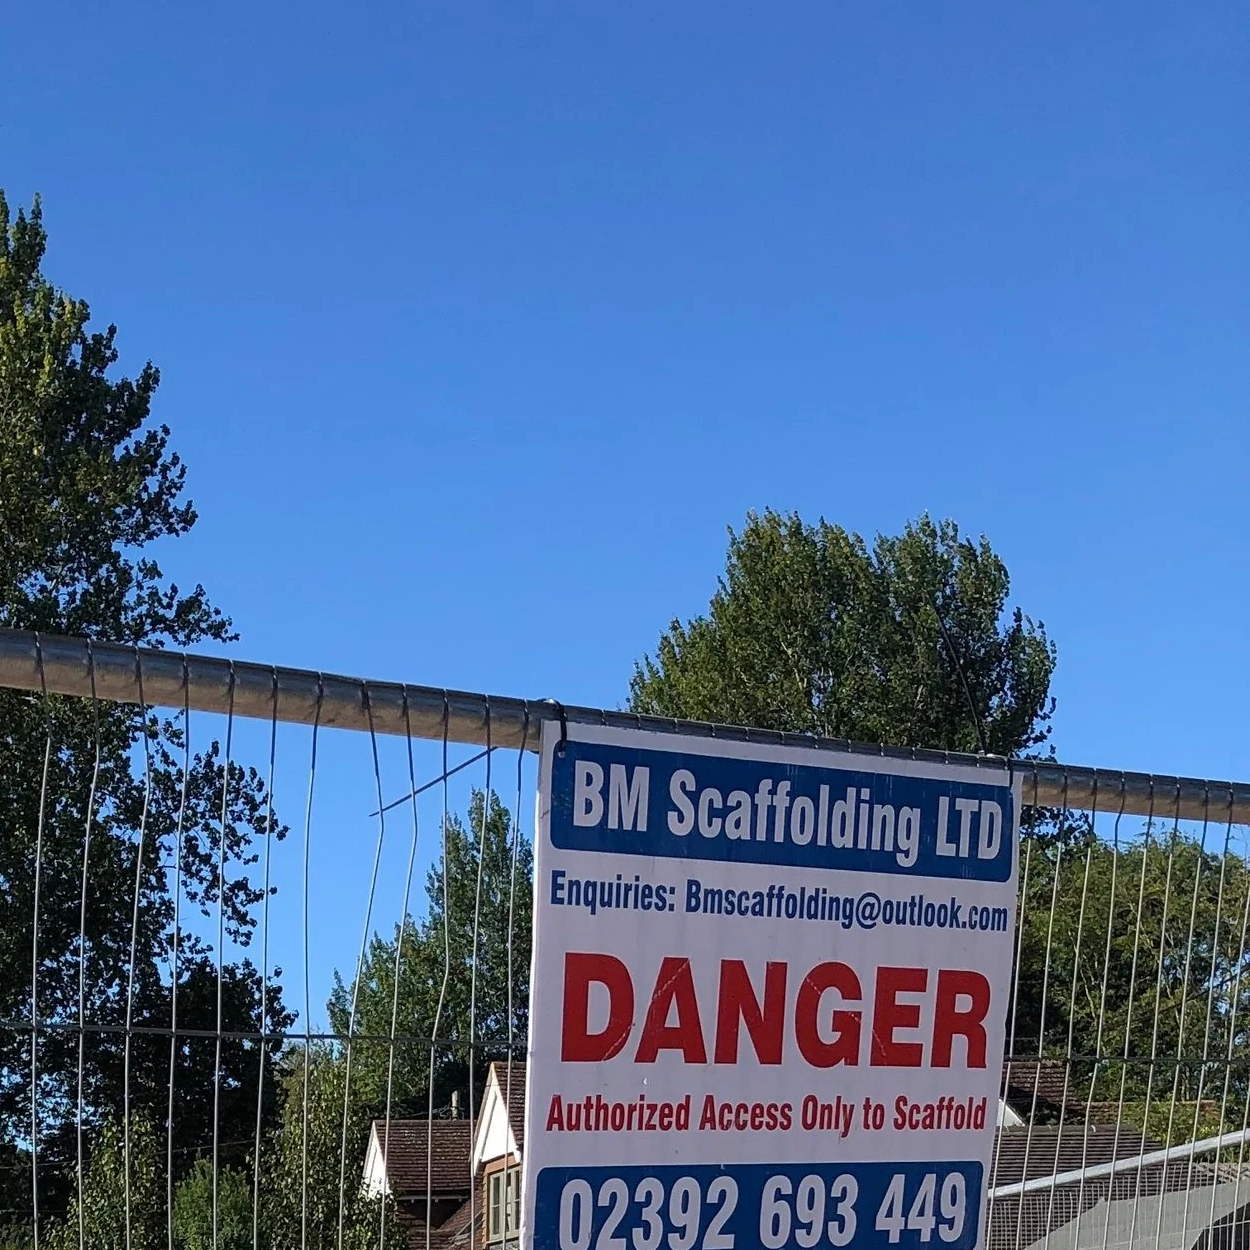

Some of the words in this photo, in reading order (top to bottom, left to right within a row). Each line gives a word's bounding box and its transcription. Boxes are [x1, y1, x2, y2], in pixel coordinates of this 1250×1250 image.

[573, 761, 649, 832] BM
[667, 770, 921, 867] Scaffolding
[936, 797, 1003, 860] LTD
[551, 870, 676, 916] Enquiries:
[685, 879, 1008, 932] Bmscaffolding@outlook.com
[561, 952, 992, 1069] DANGER
[545, 1094, 690, 1132] Authorized
[699, 1095, 792, 1131] Access
[801, 1095, 854, 1138] Only
[862, 1097, 885, 1131] to
[893, 1095, 986, 1130] Scaffold
[758, 1172, 858, 1250] 693
[875, 1171, 967, 1244] 449
